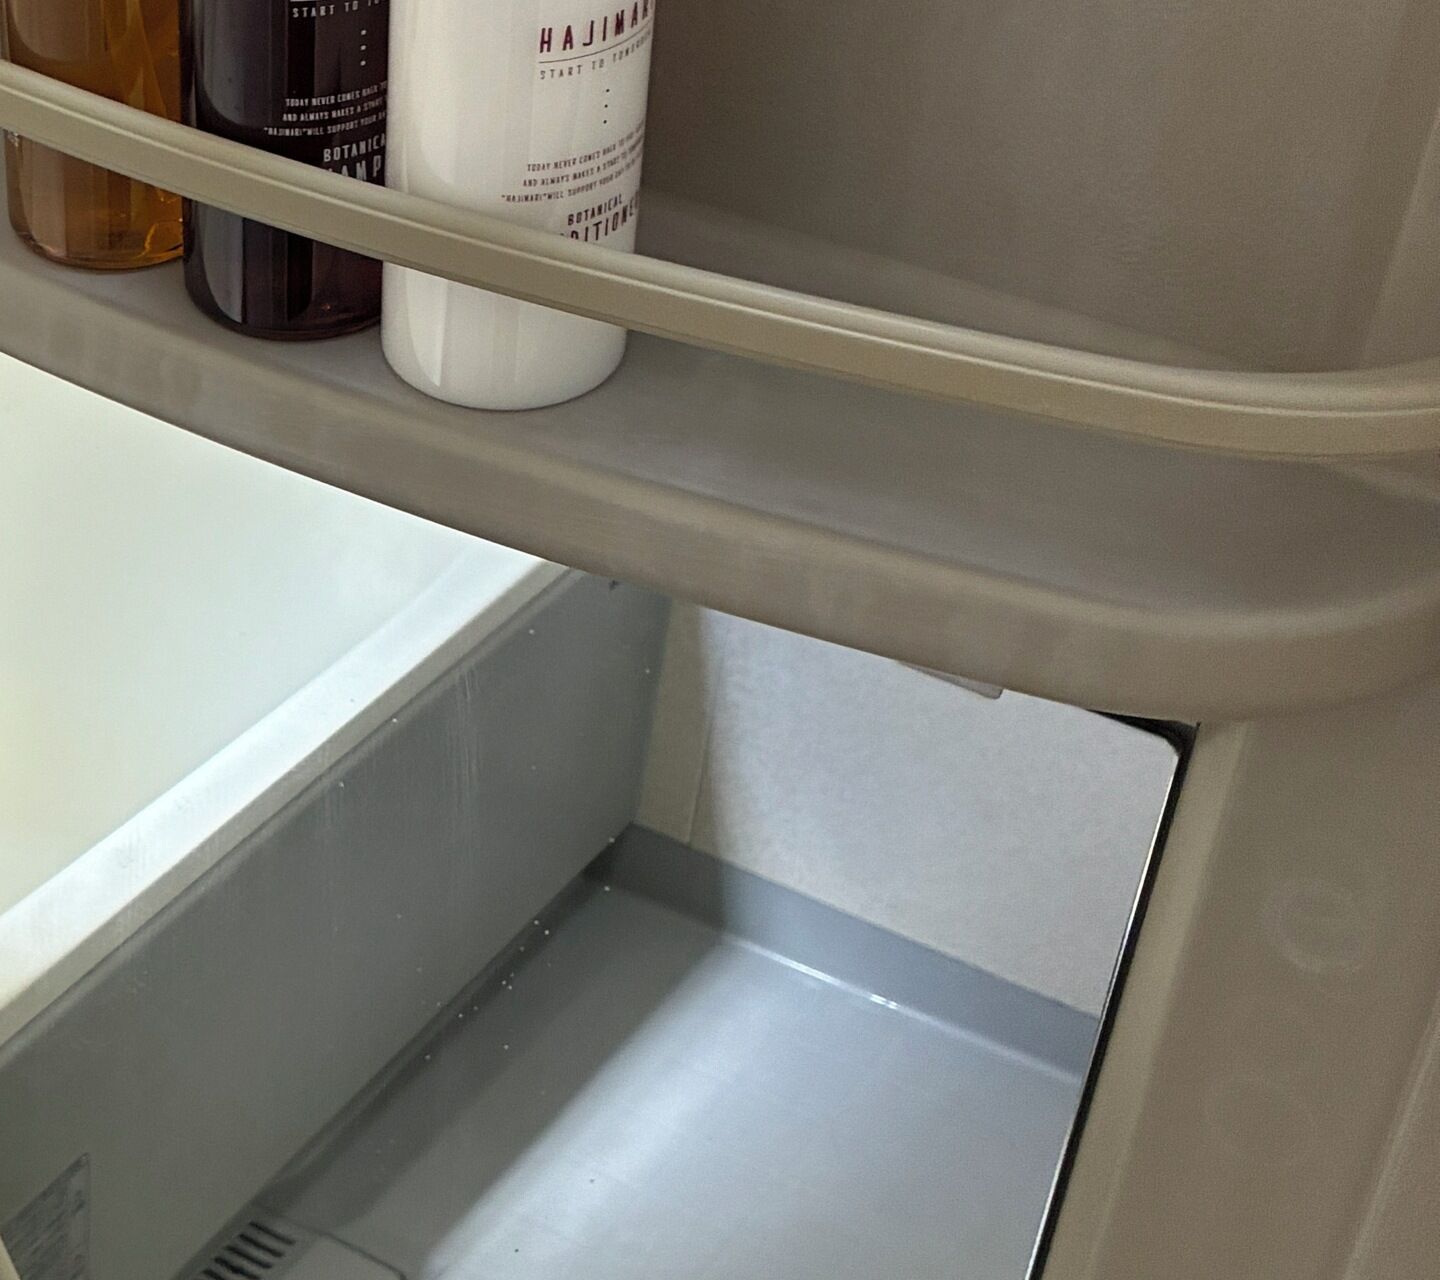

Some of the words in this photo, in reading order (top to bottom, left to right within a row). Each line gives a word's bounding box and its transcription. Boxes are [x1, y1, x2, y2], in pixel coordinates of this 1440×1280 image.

[292, 4, 335, 18] START
[344, 0, 359, 12] TO
[540, 64, 582, 80] START
[591, 58, 604, 70] TO
[285, 98, 309, 107] TODAY
[311, 95, 335, 106] NEVER
[337, 90, 360, 103] COMES
[282, 113, 298, 122] AND
[300, 111, 329, 122] ALWAYS
[331, 106, 354, 119] MAKES
[327, 119, 359, 134] SUPPORT
[527, 163, 551, 172] TODAY
[553, 158, 577, 169] NEVER
[579, 150, 601, 164] COMES
[523, 179, 537, 187] AND
[540, 174, 570, 186] ALWAYS
[572, 166, 594, 180] MAKES
[567, 181, 597, 197] SUPPORT
[567, 193, 623, 226] BOTANICAL
